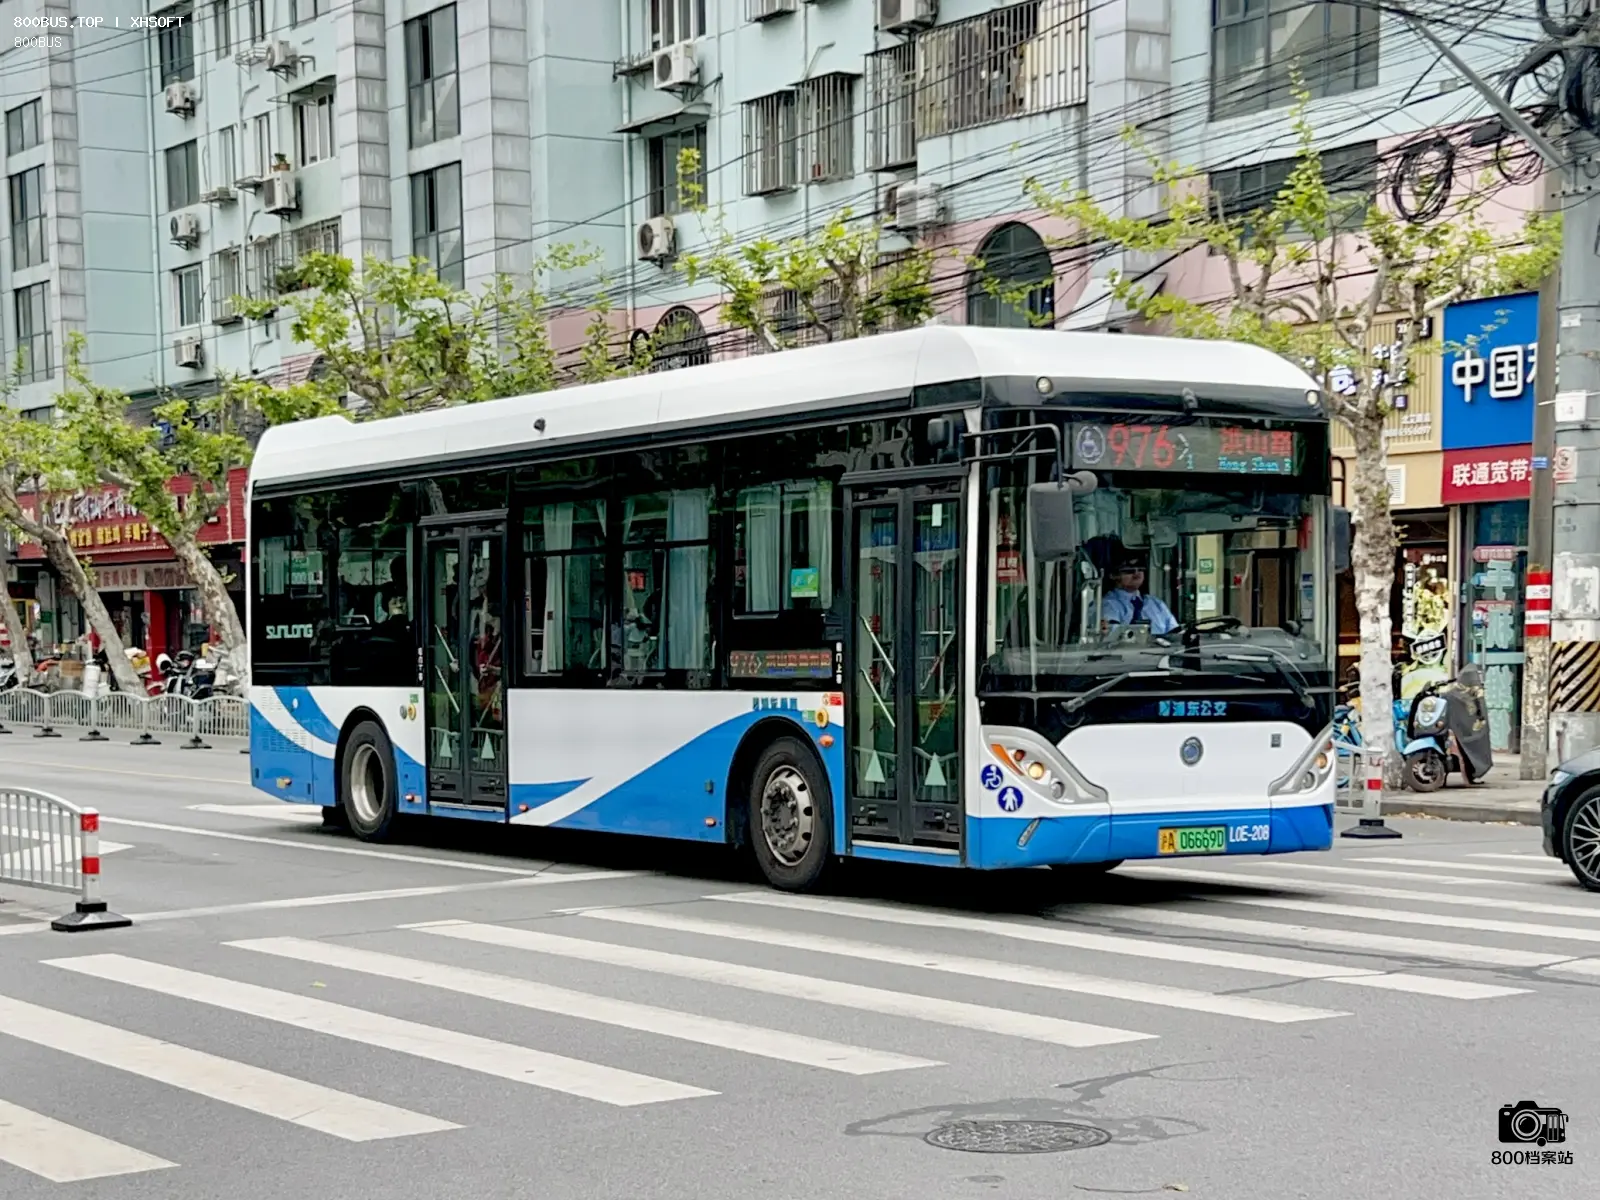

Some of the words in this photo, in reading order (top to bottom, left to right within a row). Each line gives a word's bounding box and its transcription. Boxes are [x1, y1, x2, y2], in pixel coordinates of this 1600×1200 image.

[1108, 424, 1175, 468] 976
[1451, 458, 1532, 487] 联通宽带
